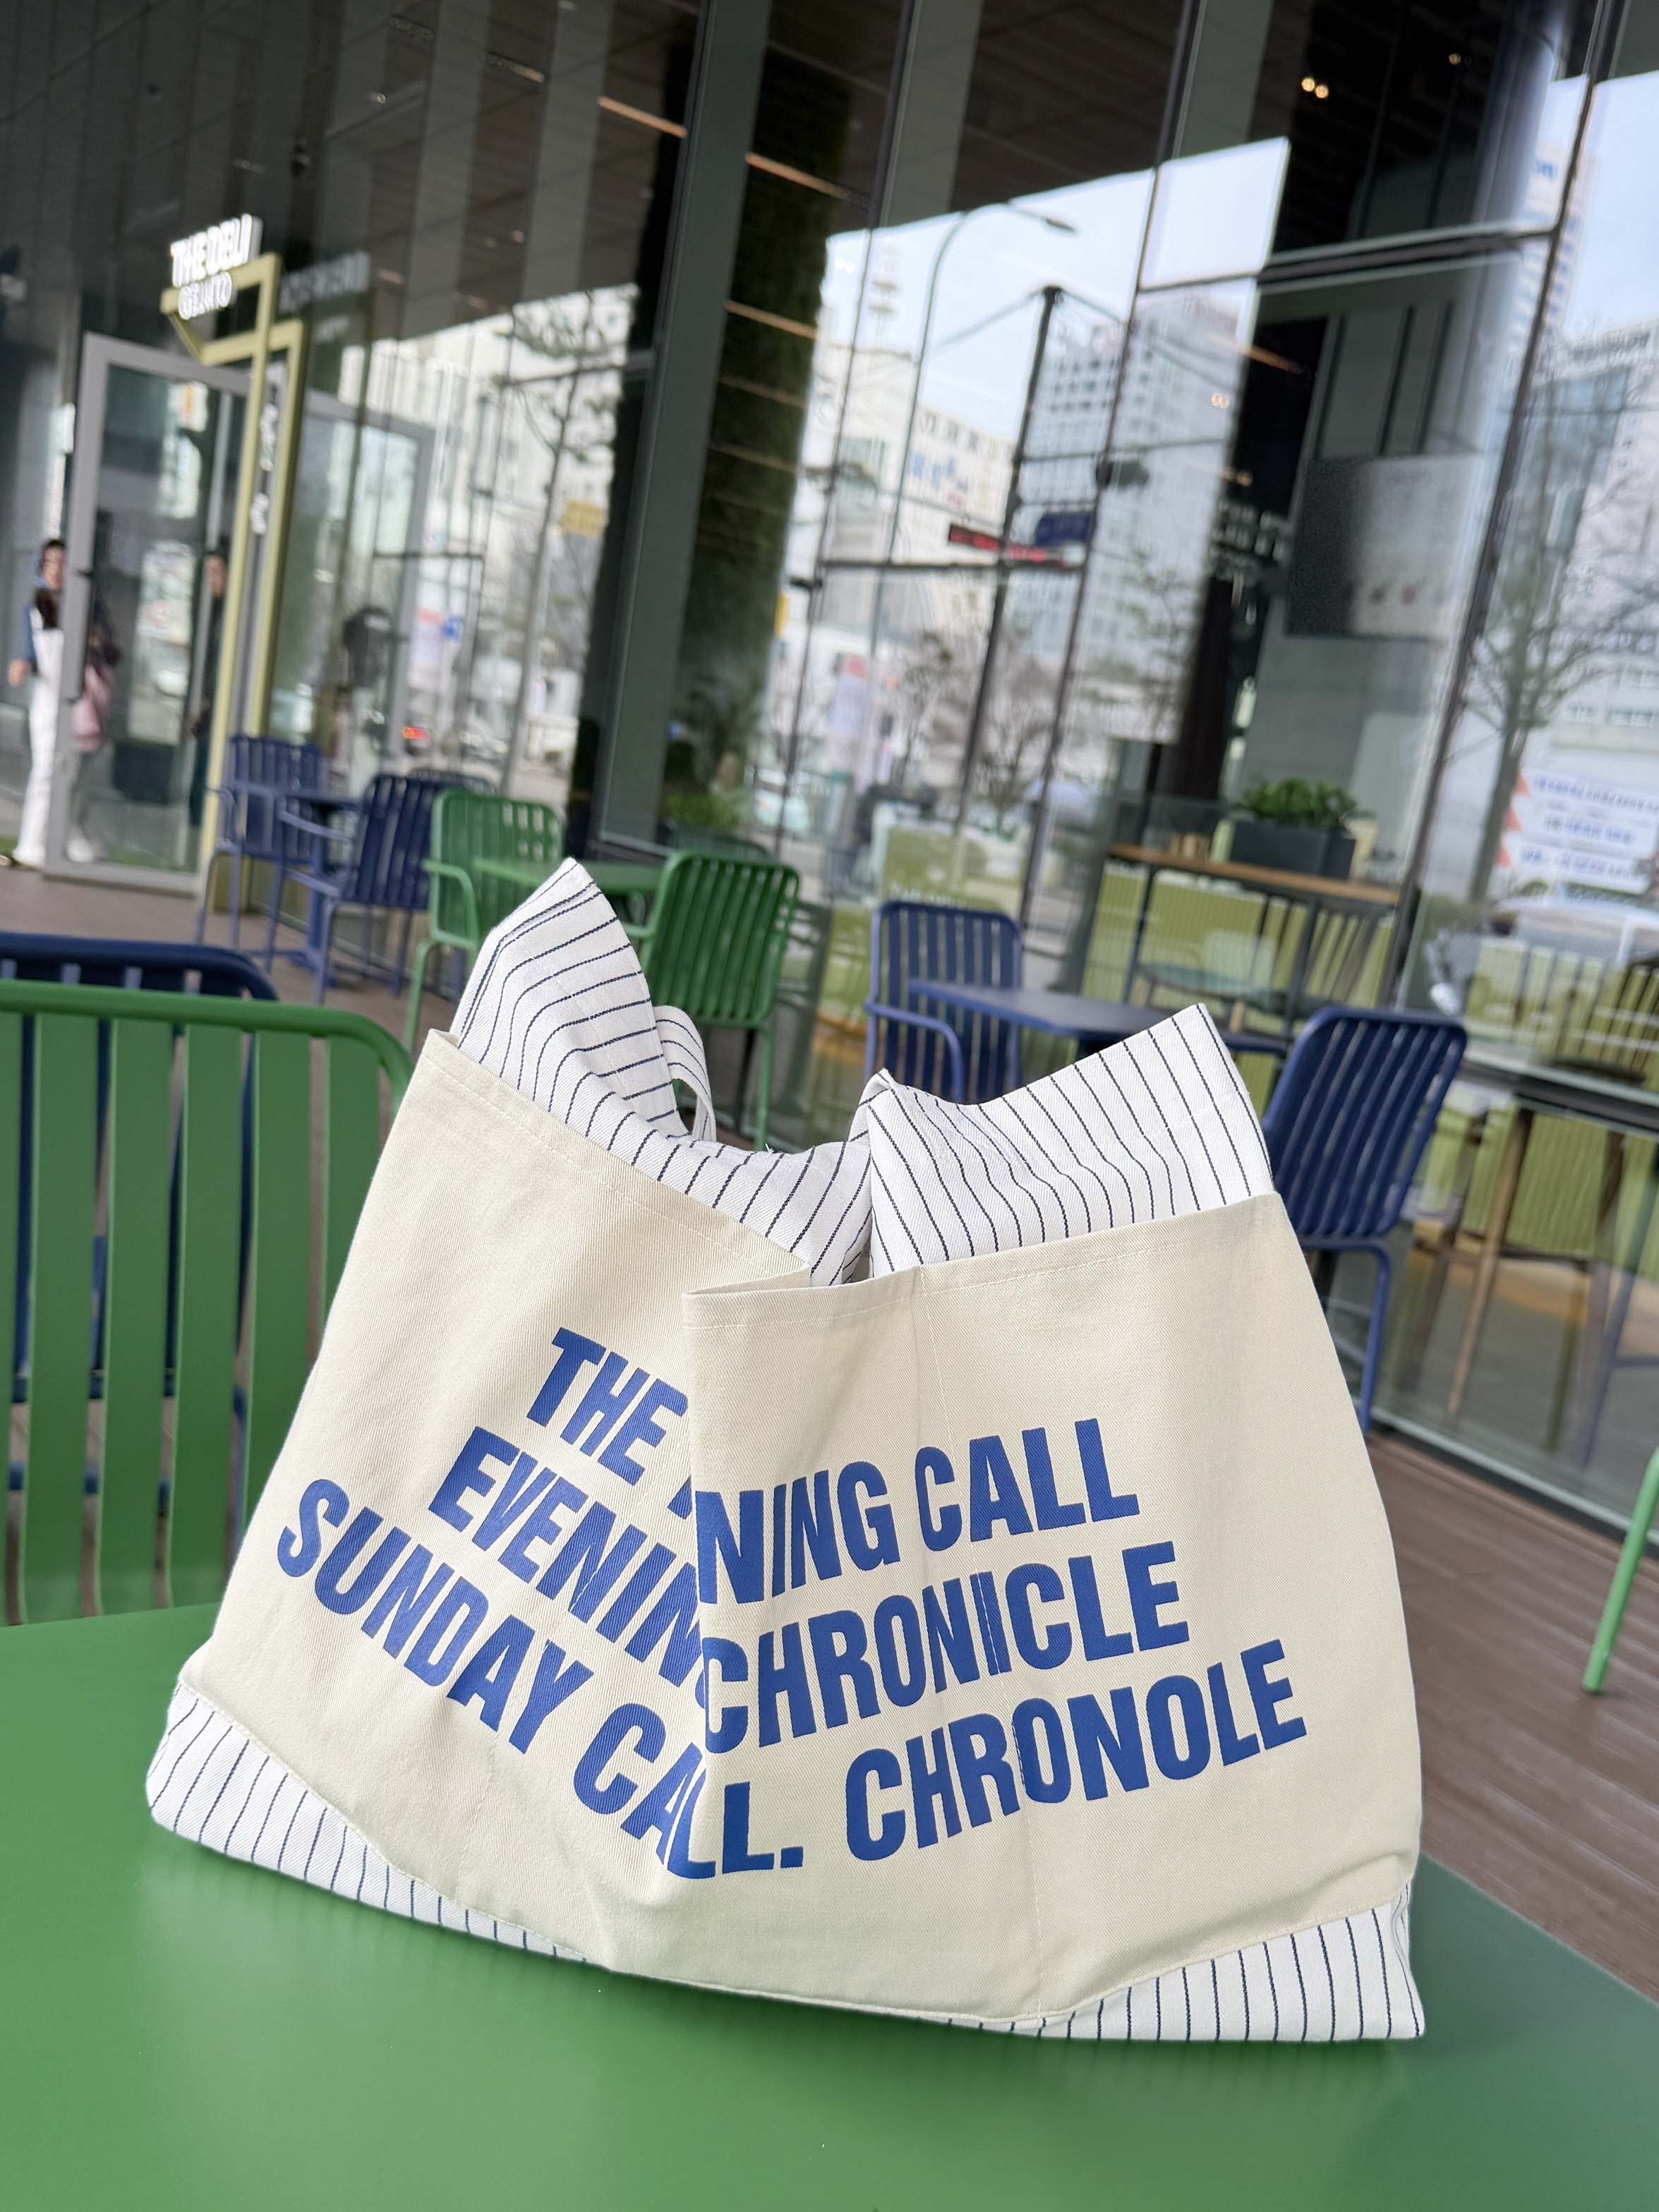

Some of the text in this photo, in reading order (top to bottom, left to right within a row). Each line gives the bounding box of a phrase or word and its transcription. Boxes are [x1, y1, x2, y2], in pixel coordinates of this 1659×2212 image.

[170, 214, 253, 287] THE DELI
[527, 1327, 688, 1485] THE
[915, 1418, 1140, 1552] CALL
[277, 1478, 594, 1755] SUNDAY
[846, 1639, 1308, 1861] CHRONOLE
[702, 1541, 1190, 1754] CHRONICLE
